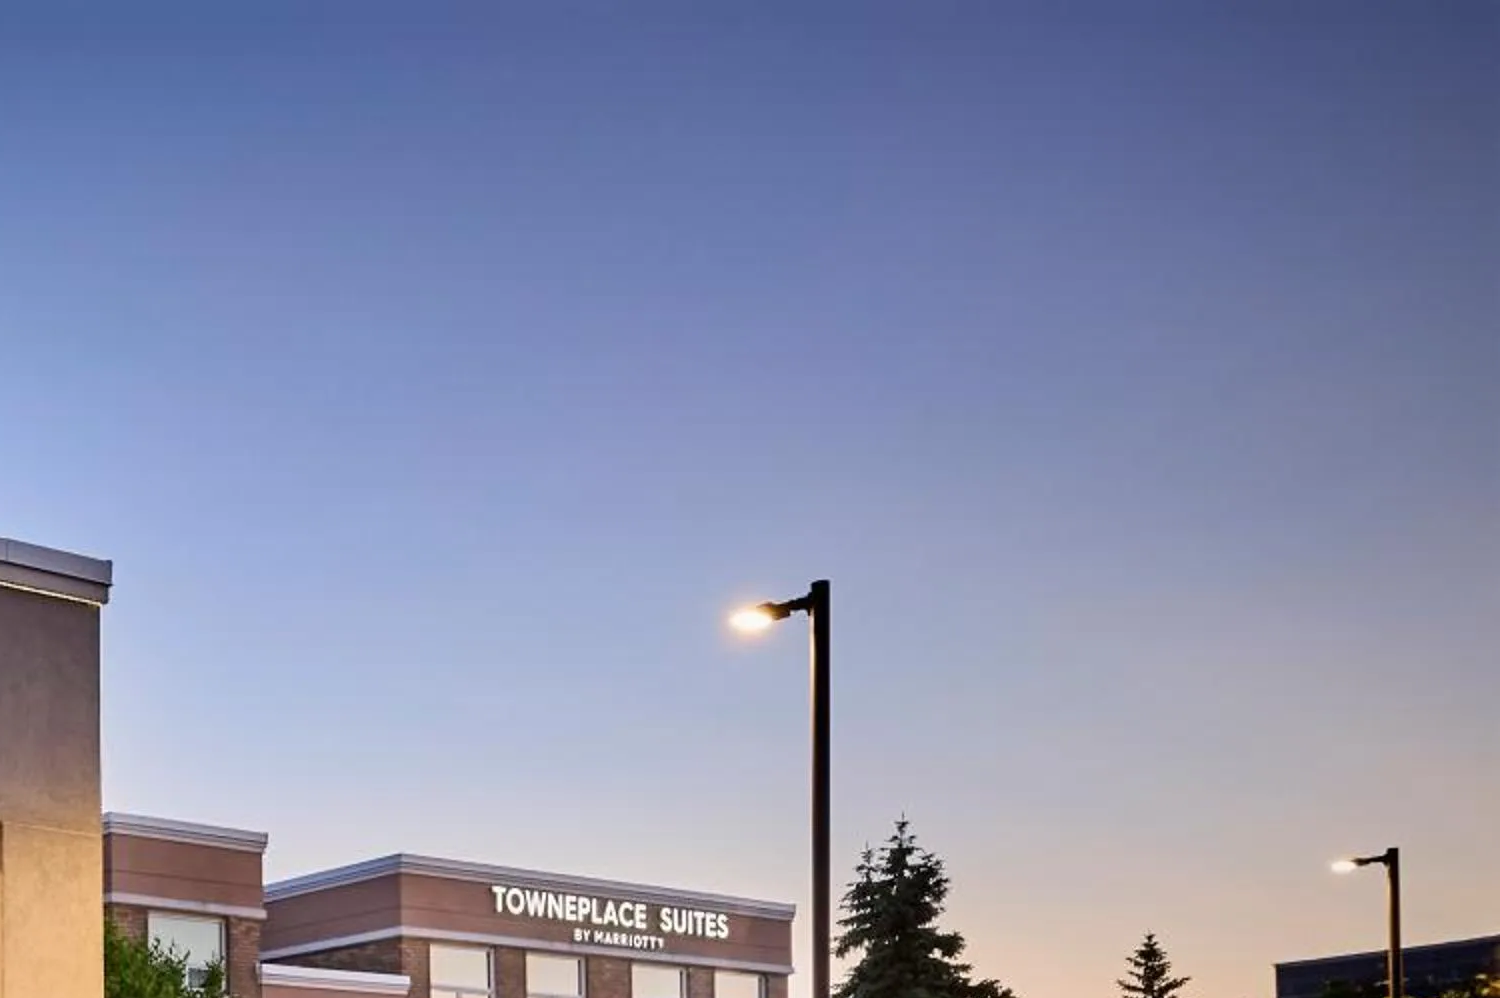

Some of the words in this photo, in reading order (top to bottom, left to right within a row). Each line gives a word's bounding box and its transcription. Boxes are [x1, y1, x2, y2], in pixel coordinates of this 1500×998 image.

[492, 885, 647, 929] TOWNEPLACE
[659, 907, 729, 938] SUITES
[573, 928, 590, 942] BY
